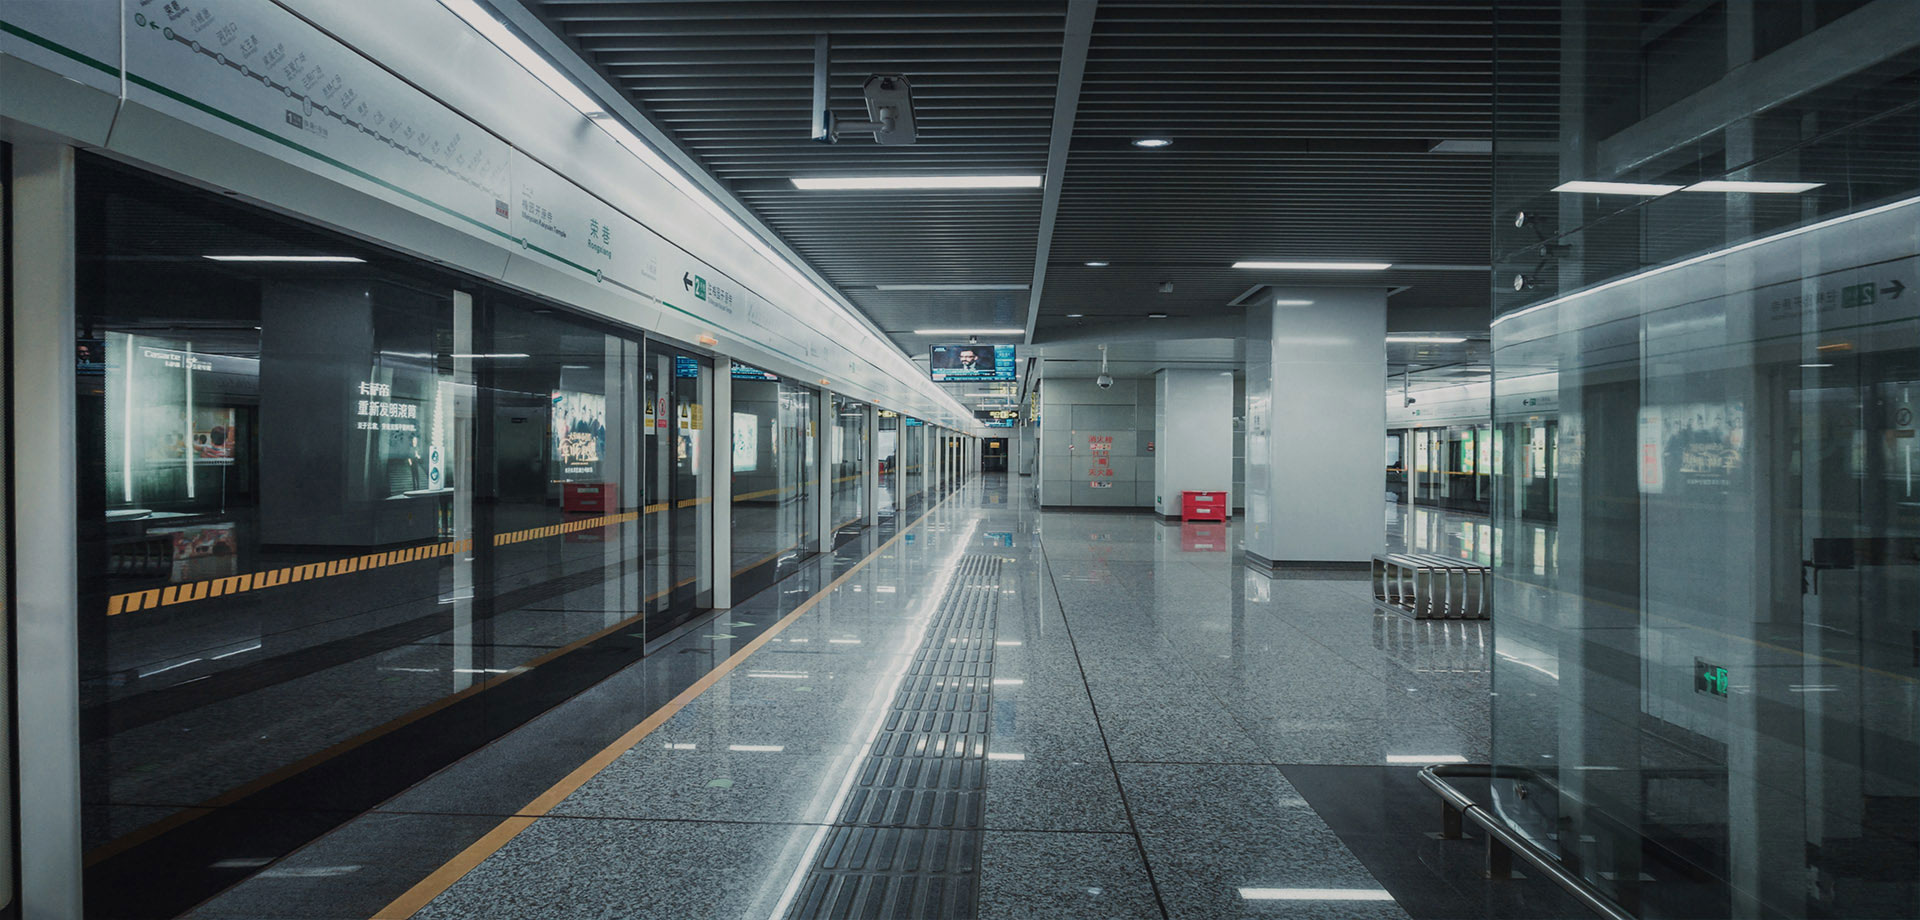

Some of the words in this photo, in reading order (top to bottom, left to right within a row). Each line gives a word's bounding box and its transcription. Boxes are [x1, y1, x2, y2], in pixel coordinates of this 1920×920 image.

[590, 218, 610, 245] 荣巷
[588, 239, 611, 260] Rongxiang
[144, 350, 181, 361] Casarte
[358, 381, 390, 397] 卡萨帝
[357, 400, 417, 419] 重新发明滚筒
